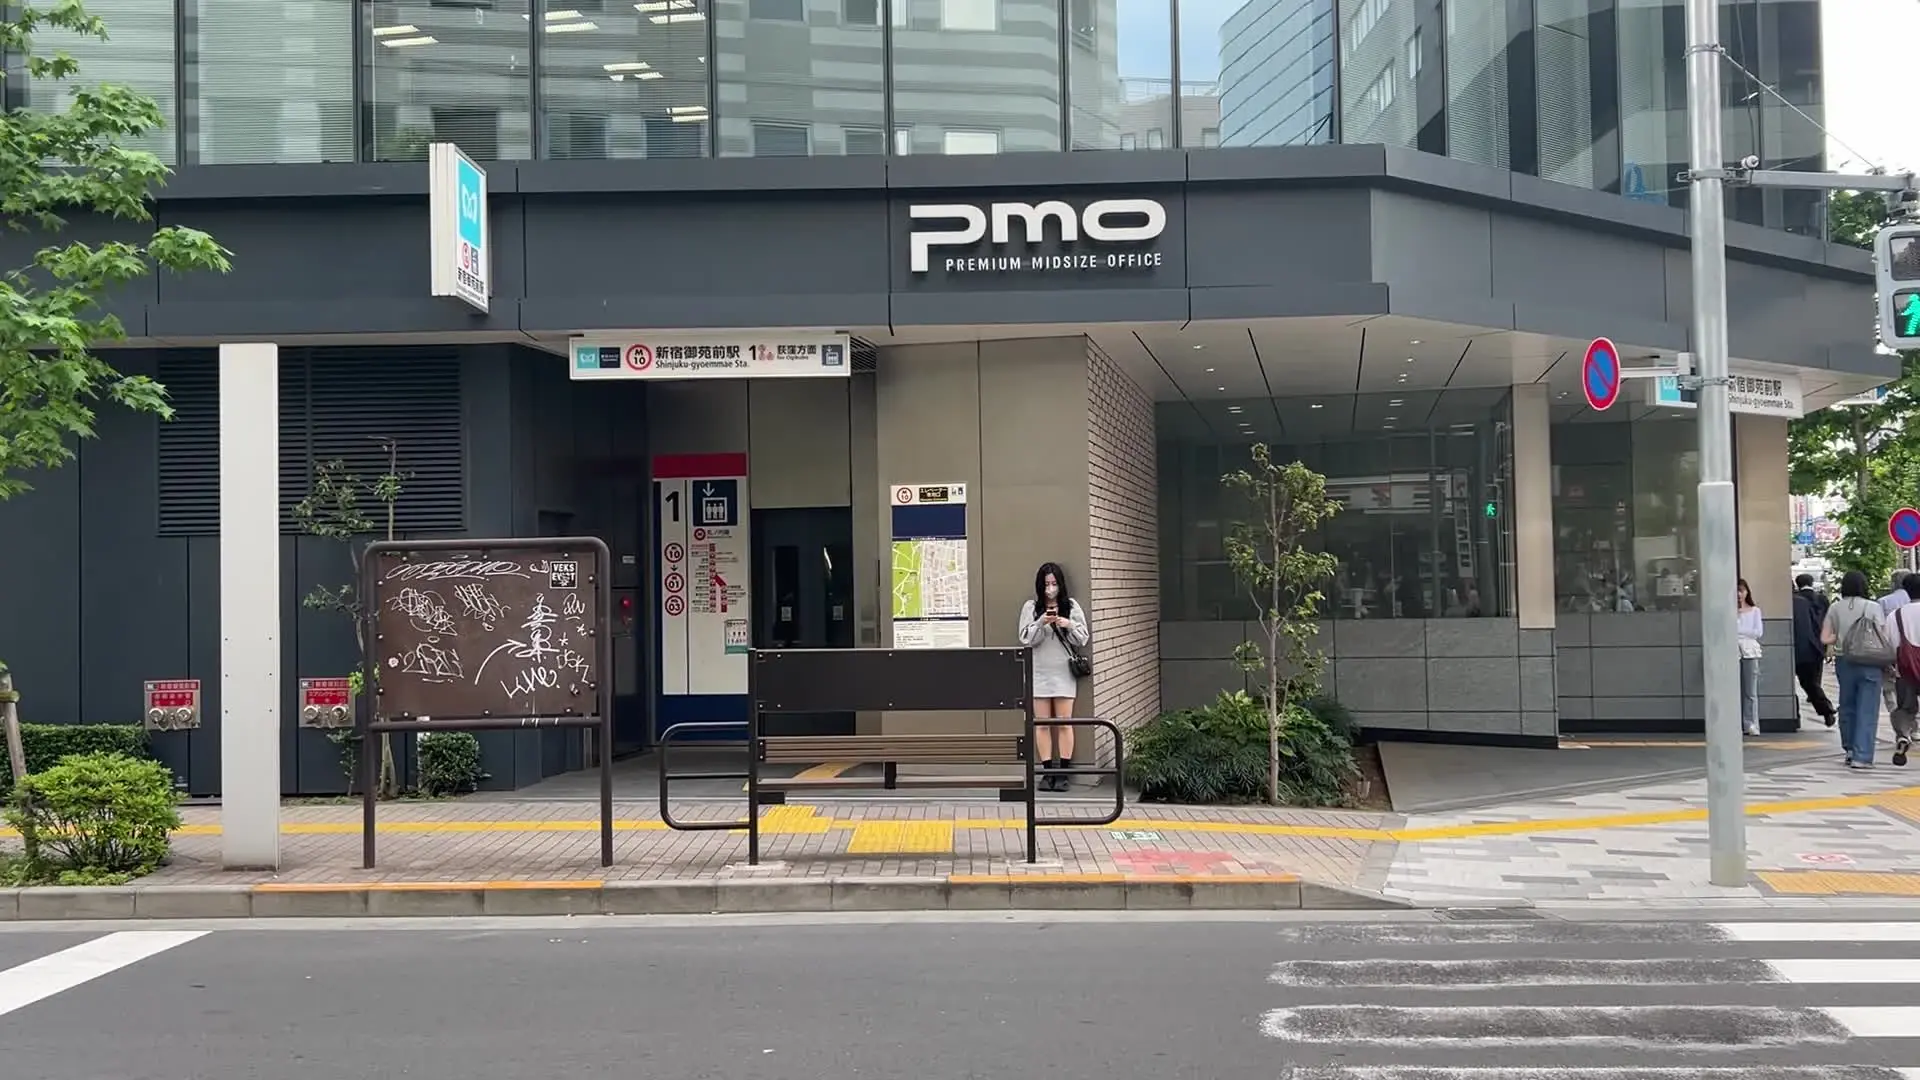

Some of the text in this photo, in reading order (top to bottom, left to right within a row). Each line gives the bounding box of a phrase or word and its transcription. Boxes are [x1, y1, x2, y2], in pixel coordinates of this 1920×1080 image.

[946, 252, 1163, 272] PREMIUM MIDSIZE OFFICE
[634, 348, 644, 356] M
[655, 345, 740, 359] 新宿御苑前駅
[748, 344, 757, 361] 1
[633, 356, 646, 365] 10
[655, 360, 733, 371] Shinjuku-gyoemmae
[664, 490, 680, 522] 1
[668, 550, 681, 559] 10
[553, 563, 575, 572] VEKS
[668, 579, 680, 588] 01
[668, 602, 681, 612] 03
